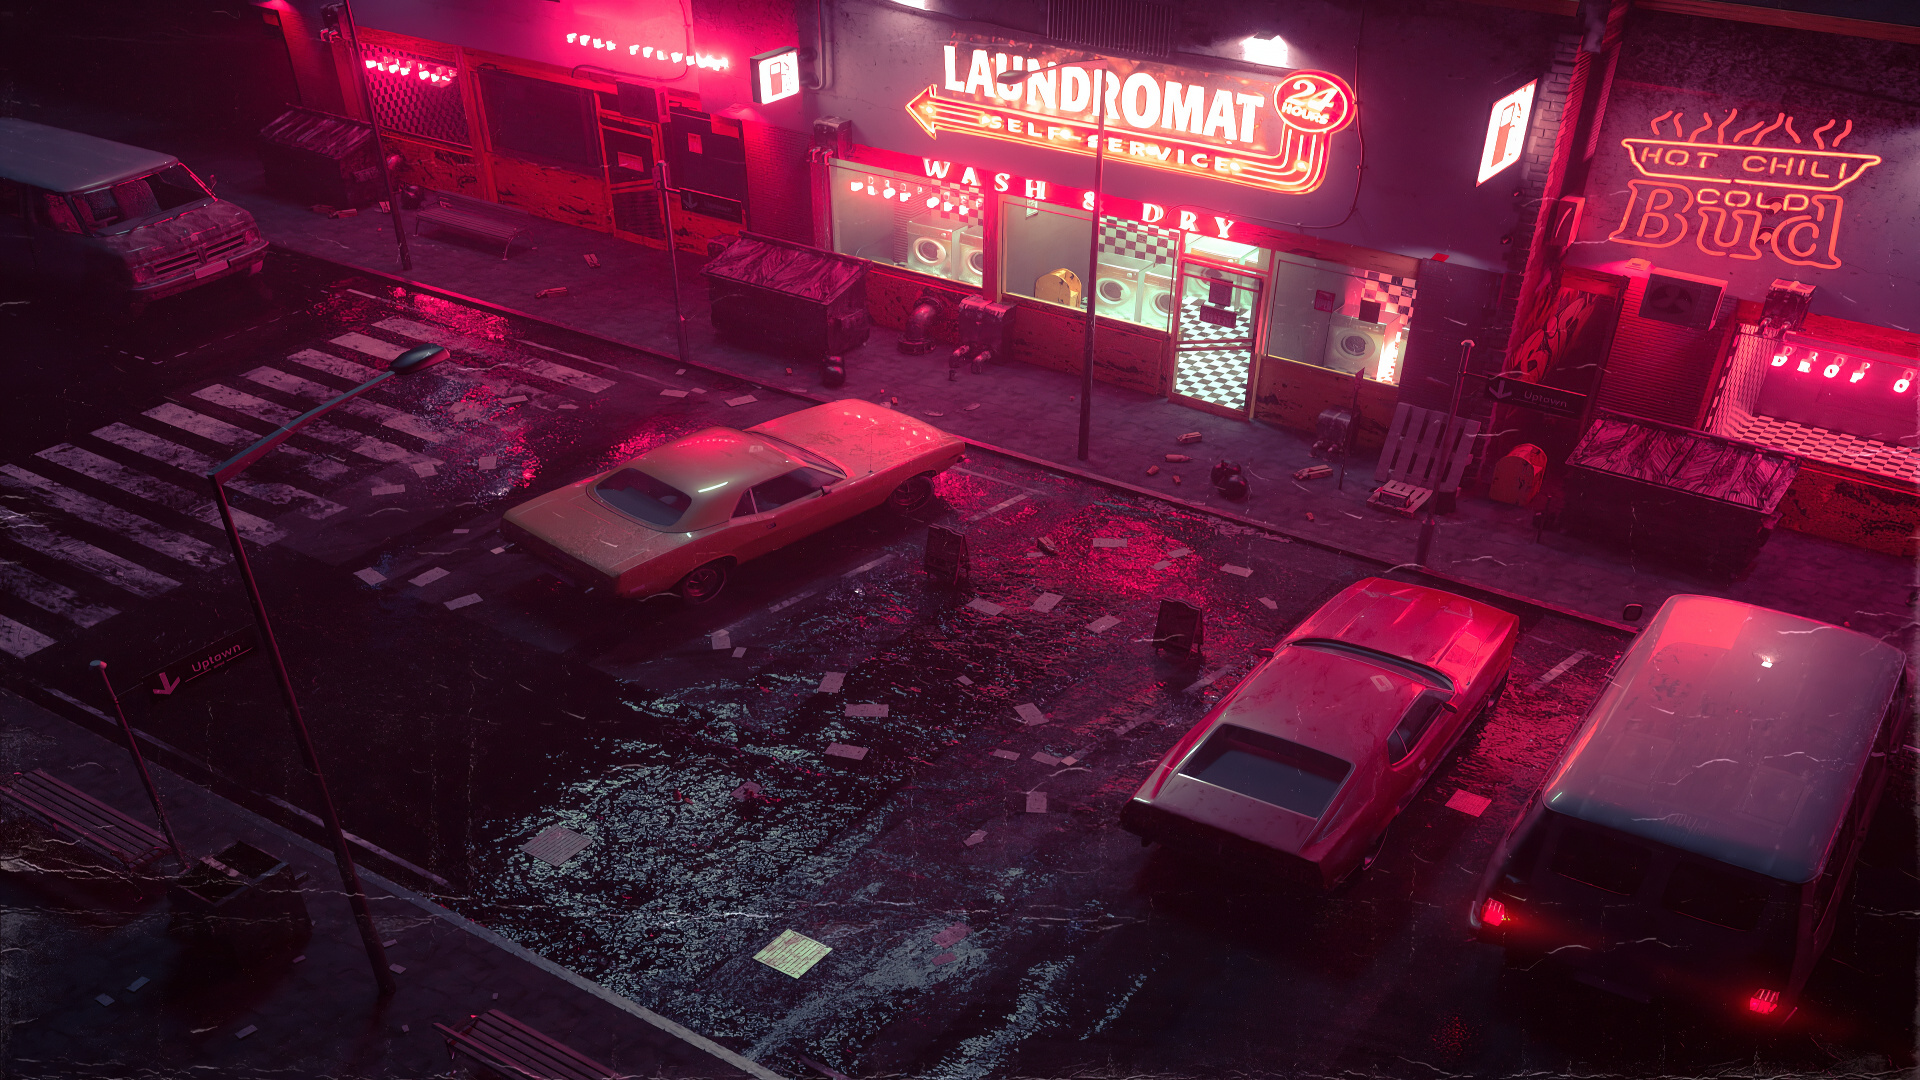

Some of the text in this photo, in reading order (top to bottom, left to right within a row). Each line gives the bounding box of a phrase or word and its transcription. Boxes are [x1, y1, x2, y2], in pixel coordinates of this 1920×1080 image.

[944, 45, 1265, 143] LAUNDROMAT
[1285, 79, 1338, 112] 24
[1281, 101, 1330, 124] HOURS
[1640, 147, 1847, 180] HOT CHILI
[922, 157, 1234, 239] WASH & DRY
[1697, 188, 1810, 211] COLD
[1771, 353, 1866, 384] DROP
[1524, 390, 1568, 408] Uptown
[191, 644, 242, 673] Uptown
